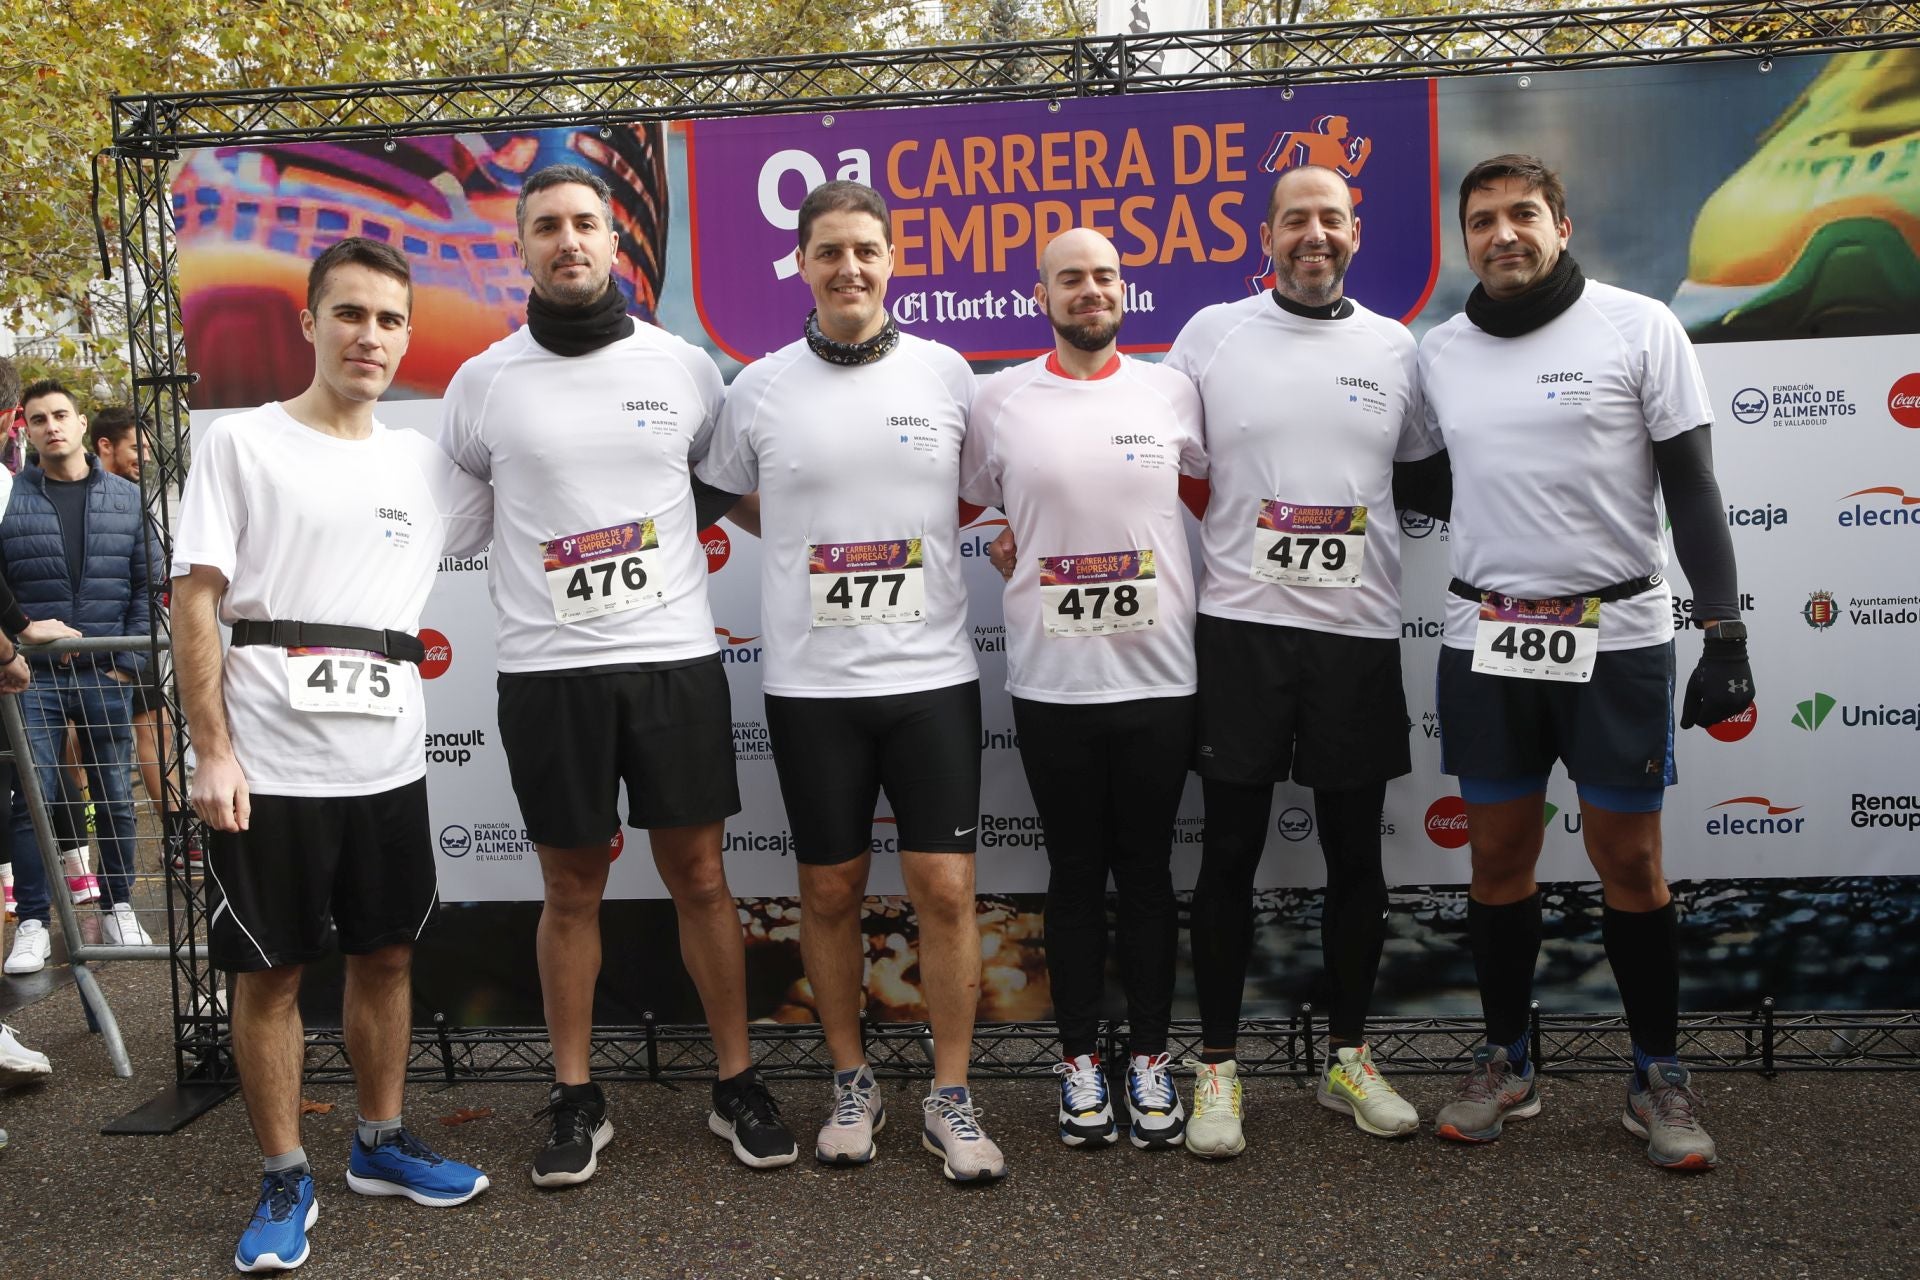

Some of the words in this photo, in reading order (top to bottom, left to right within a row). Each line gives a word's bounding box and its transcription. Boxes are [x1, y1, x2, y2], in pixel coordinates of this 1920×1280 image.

[886, 127, 1156, 200] CARRERA
[1172, 122, 1247, 186] DE
[891, 190, 1248, 278] EMPRESAS
[892, 292, 927, 325] El
[931, 289, 1008, 322] Norte
[1012, 289, 1040, 318] de
[1772, 383, 1815, 392] FUNDACIÓN
[1772, 391, 1822, 405] BANCO
[1825, 390, 1846, 402] DE
[1773, 403, 1857, 419] ALIMENTOS
[1784, 418, 1828, 427] VALLADOLID
[1292, 514, 1332, 524] EMPRESAS
[1293, 507, 1324, 516] CARRERA
[1324, 508, 1334, 516] DE
[1725, 503, 1788, 531] icaja
[1838, 504, 1920, 527] elecno
[577, 531, 610, 545] CARRERA
[611, 528, 620, 538] DE
[578, 536, 622, 553] EMPRESAS
[845, 544, 878, 554] CARRERA
[878, 544, 888, 552] DE
[845, 551, 888, 563] EMPRESAS
[1267, 536, 1346, 571] 479
[437, 556, 488, 572] alladol
[1075, 556, 1108, 566] CARRERA
[1108, 555, 1118, 563] DE
[1076, 562, 1119, 574] EMPRESAS
[566, 556, 648, 602] 476
[826, 573, 906, 609] 477
[1058, 584, 1140, 620] 478
[1672, 593, 1755, 613] Relt
[1849, 595, 1920, 608] Ayuntamient
[1849, 608, 1920, 625] Vallado
[1490, 626, 1577, 664] 480
[307, 658, 391, 698] 475
[1842, 704, 1920, 731] Unicaj
[733, 728, 768, 740] ANCO
[425, 748, 471, 767] roup
[1851, 793, 1920, 811] Renau
[1706, 813, 1805, 835] elecnor
[474, 829, 517, 841] BANCO
[521, 829, 529, 840] D
[476, 841, 537, 854] ALIMENT
[486, 854, 523, 862] VALLADOLID
